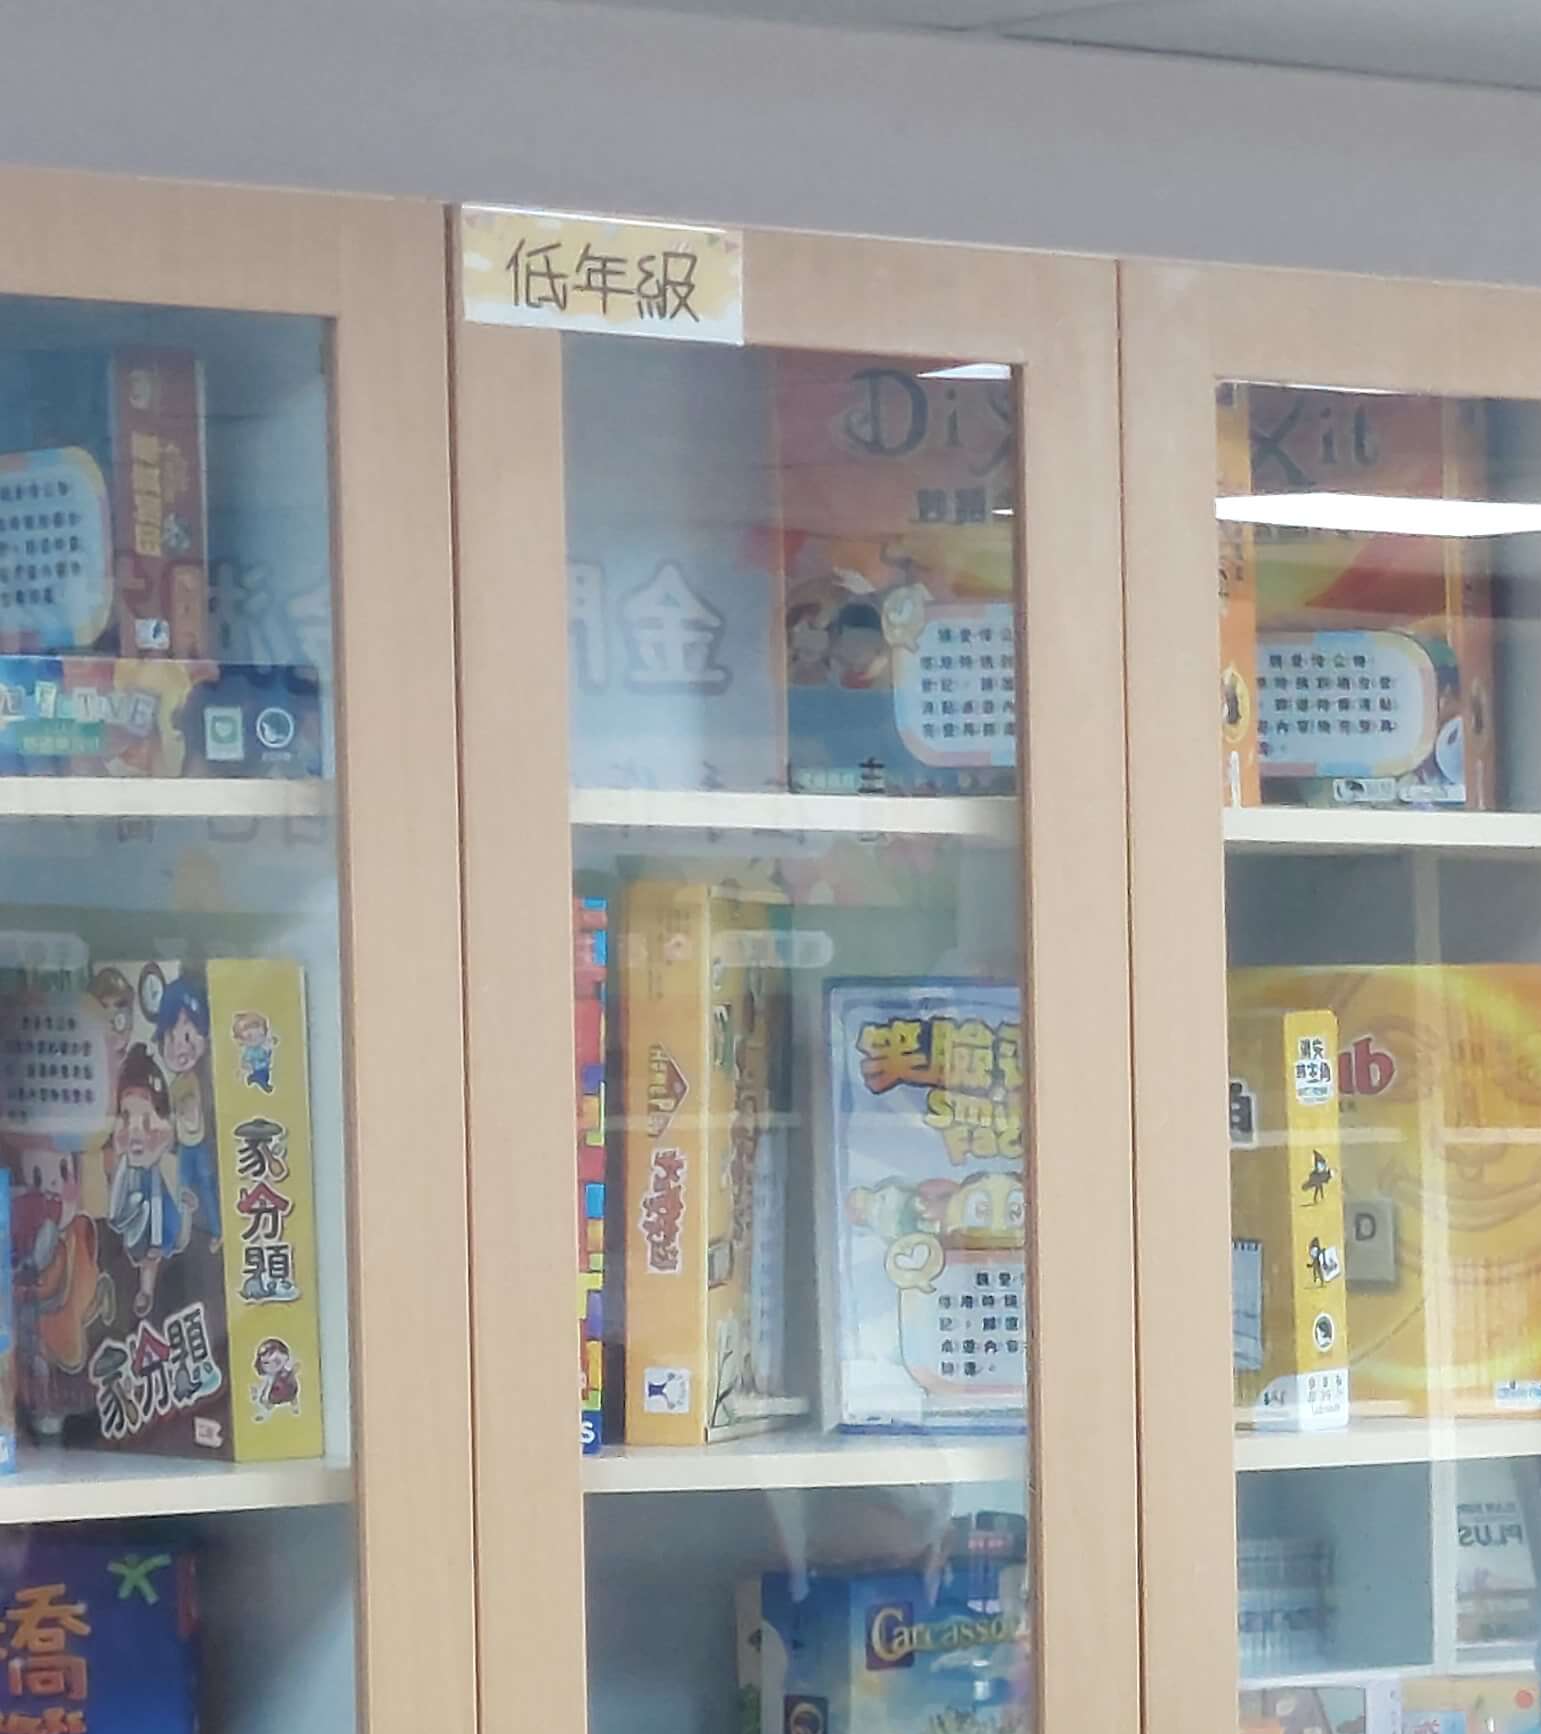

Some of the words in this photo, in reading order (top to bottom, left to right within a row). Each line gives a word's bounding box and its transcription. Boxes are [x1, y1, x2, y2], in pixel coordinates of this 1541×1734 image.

[506, 239, 699, 322] 低年級
[1355, 1212, 1376, 1241] D
